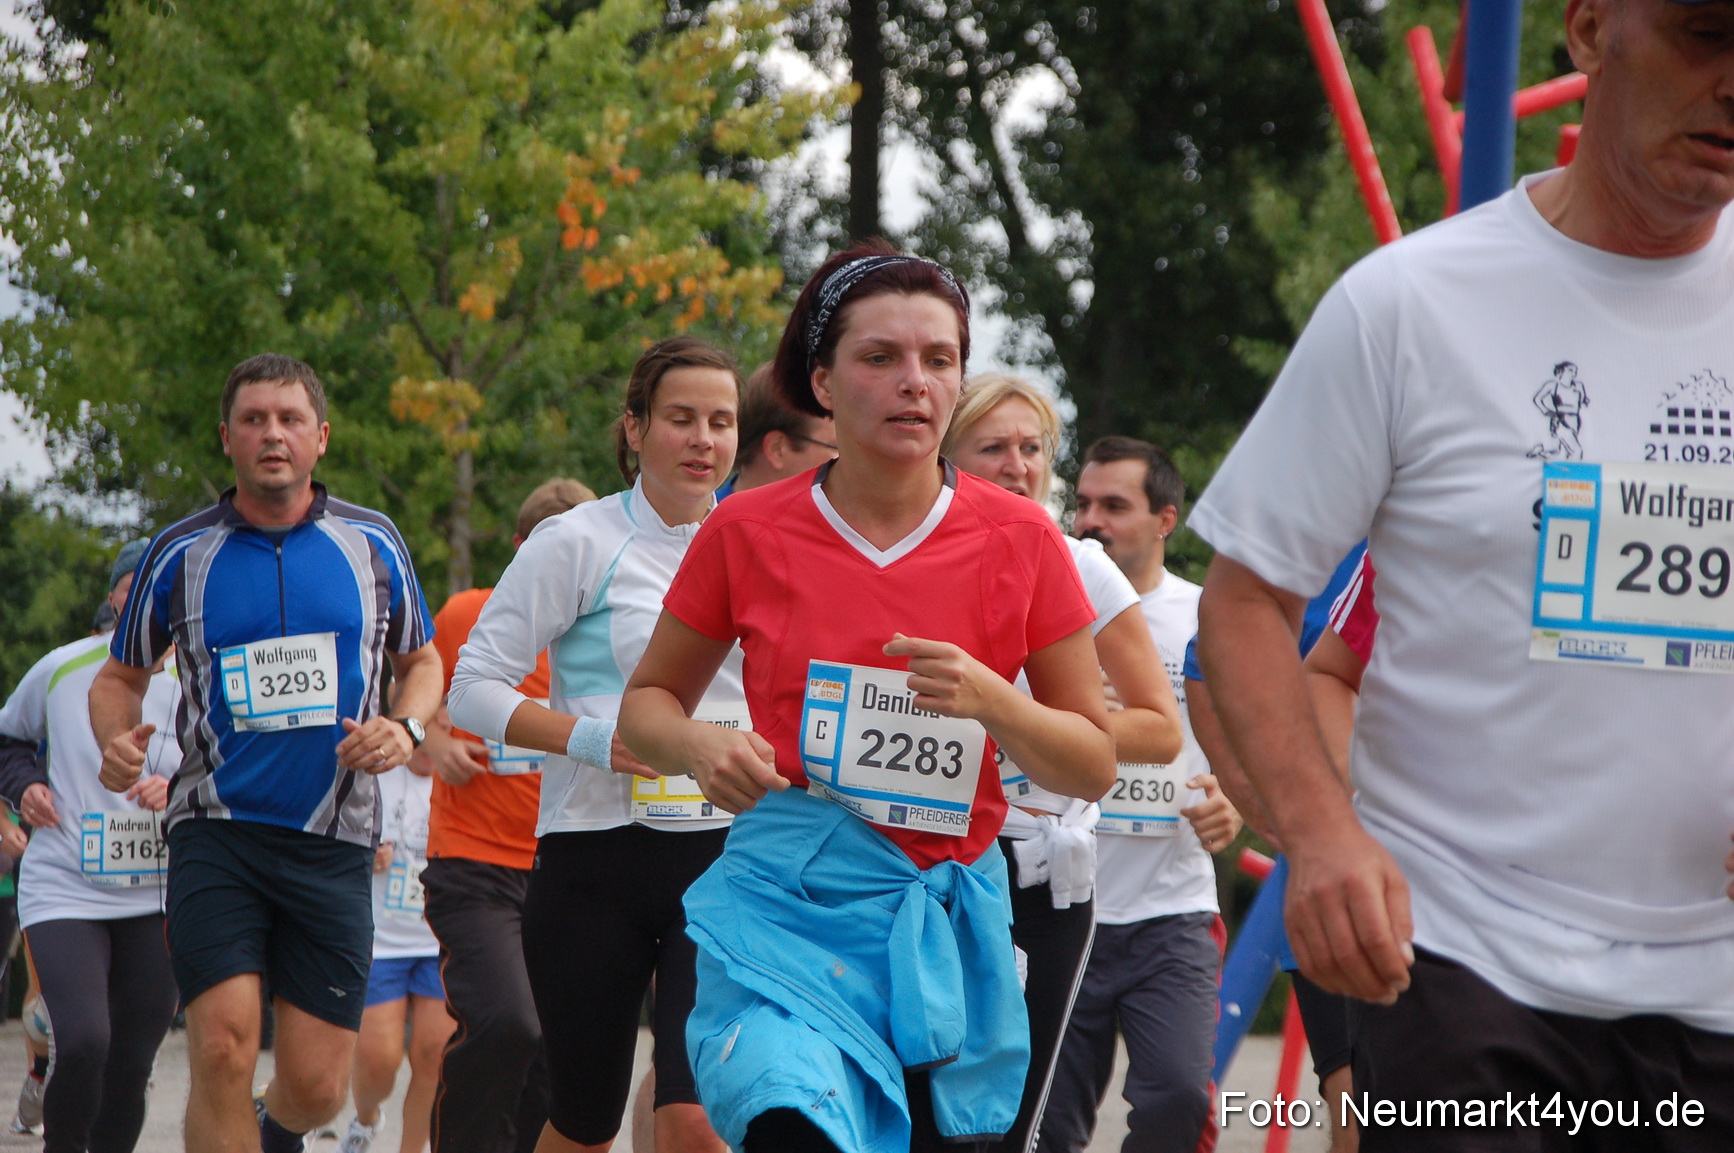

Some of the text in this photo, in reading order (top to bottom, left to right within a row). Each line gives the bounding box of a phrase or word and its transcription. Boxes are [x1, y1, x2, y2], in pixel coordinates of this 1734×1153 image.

[1645, 444, 1734, 464] 21.09.2
[1558, 533, 1572, 560] D
[253, 646, 317, 665] Wolfgang
[260, 670, 326, 697] 3293
[816, 720, 827, 740] C
[856, 729, 964, 779] 2283
[1112, 778, 1174, 802] 2630
[109, 818, 151, 831] Andrea
[910, 806, 968, 826] PFLEIDERER
[110, 840, 167, 860] 3162
